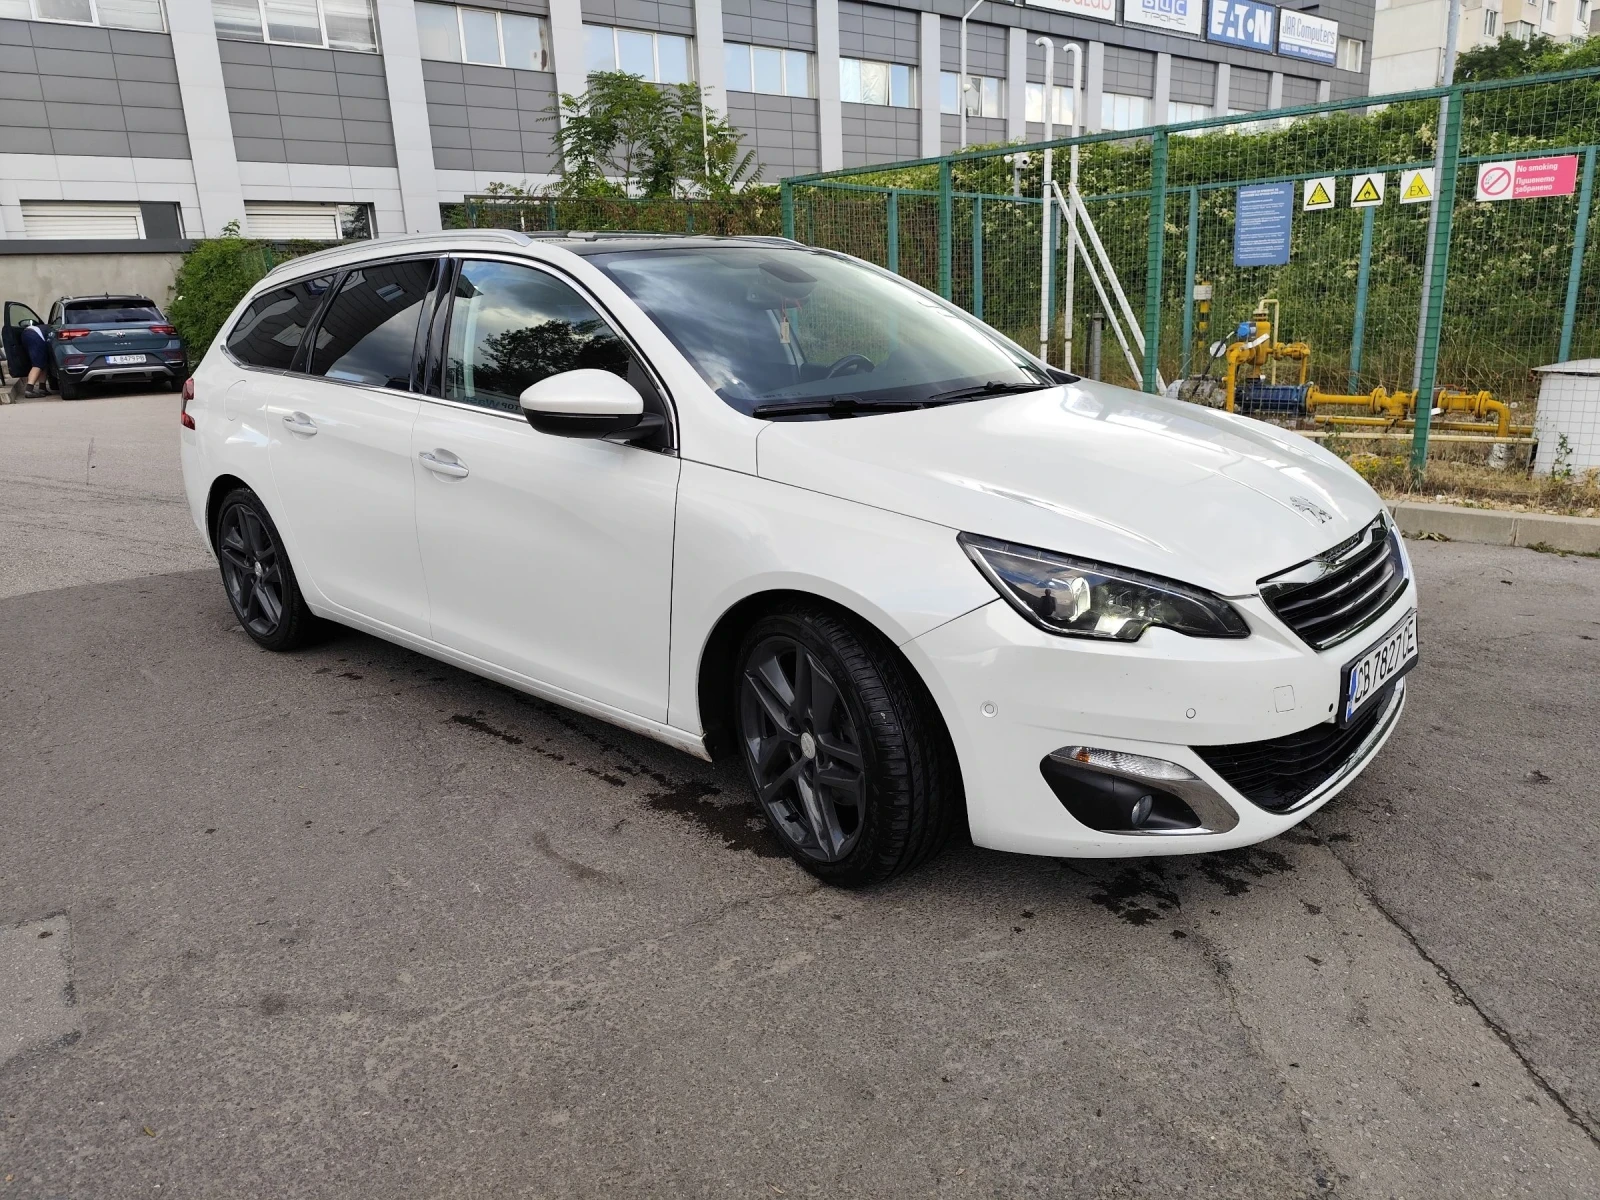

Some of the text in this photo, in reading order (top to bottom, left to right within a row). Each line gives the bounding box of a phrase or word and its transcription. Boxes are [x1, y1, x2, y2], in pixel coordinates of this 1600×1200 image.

[1211, 0, 1272, 45] EATON
[1282, 15, 1336, 45] JAR Computers
[1516, 163, 1559, 173] No smoking
[1515, 176, 1555, 186] Пушенето
[1410, 184, 1425, 197] EX
[1514, 184, 1553, 194] забранено
[1354, 618, 1415, 704] CB 7827 CE
